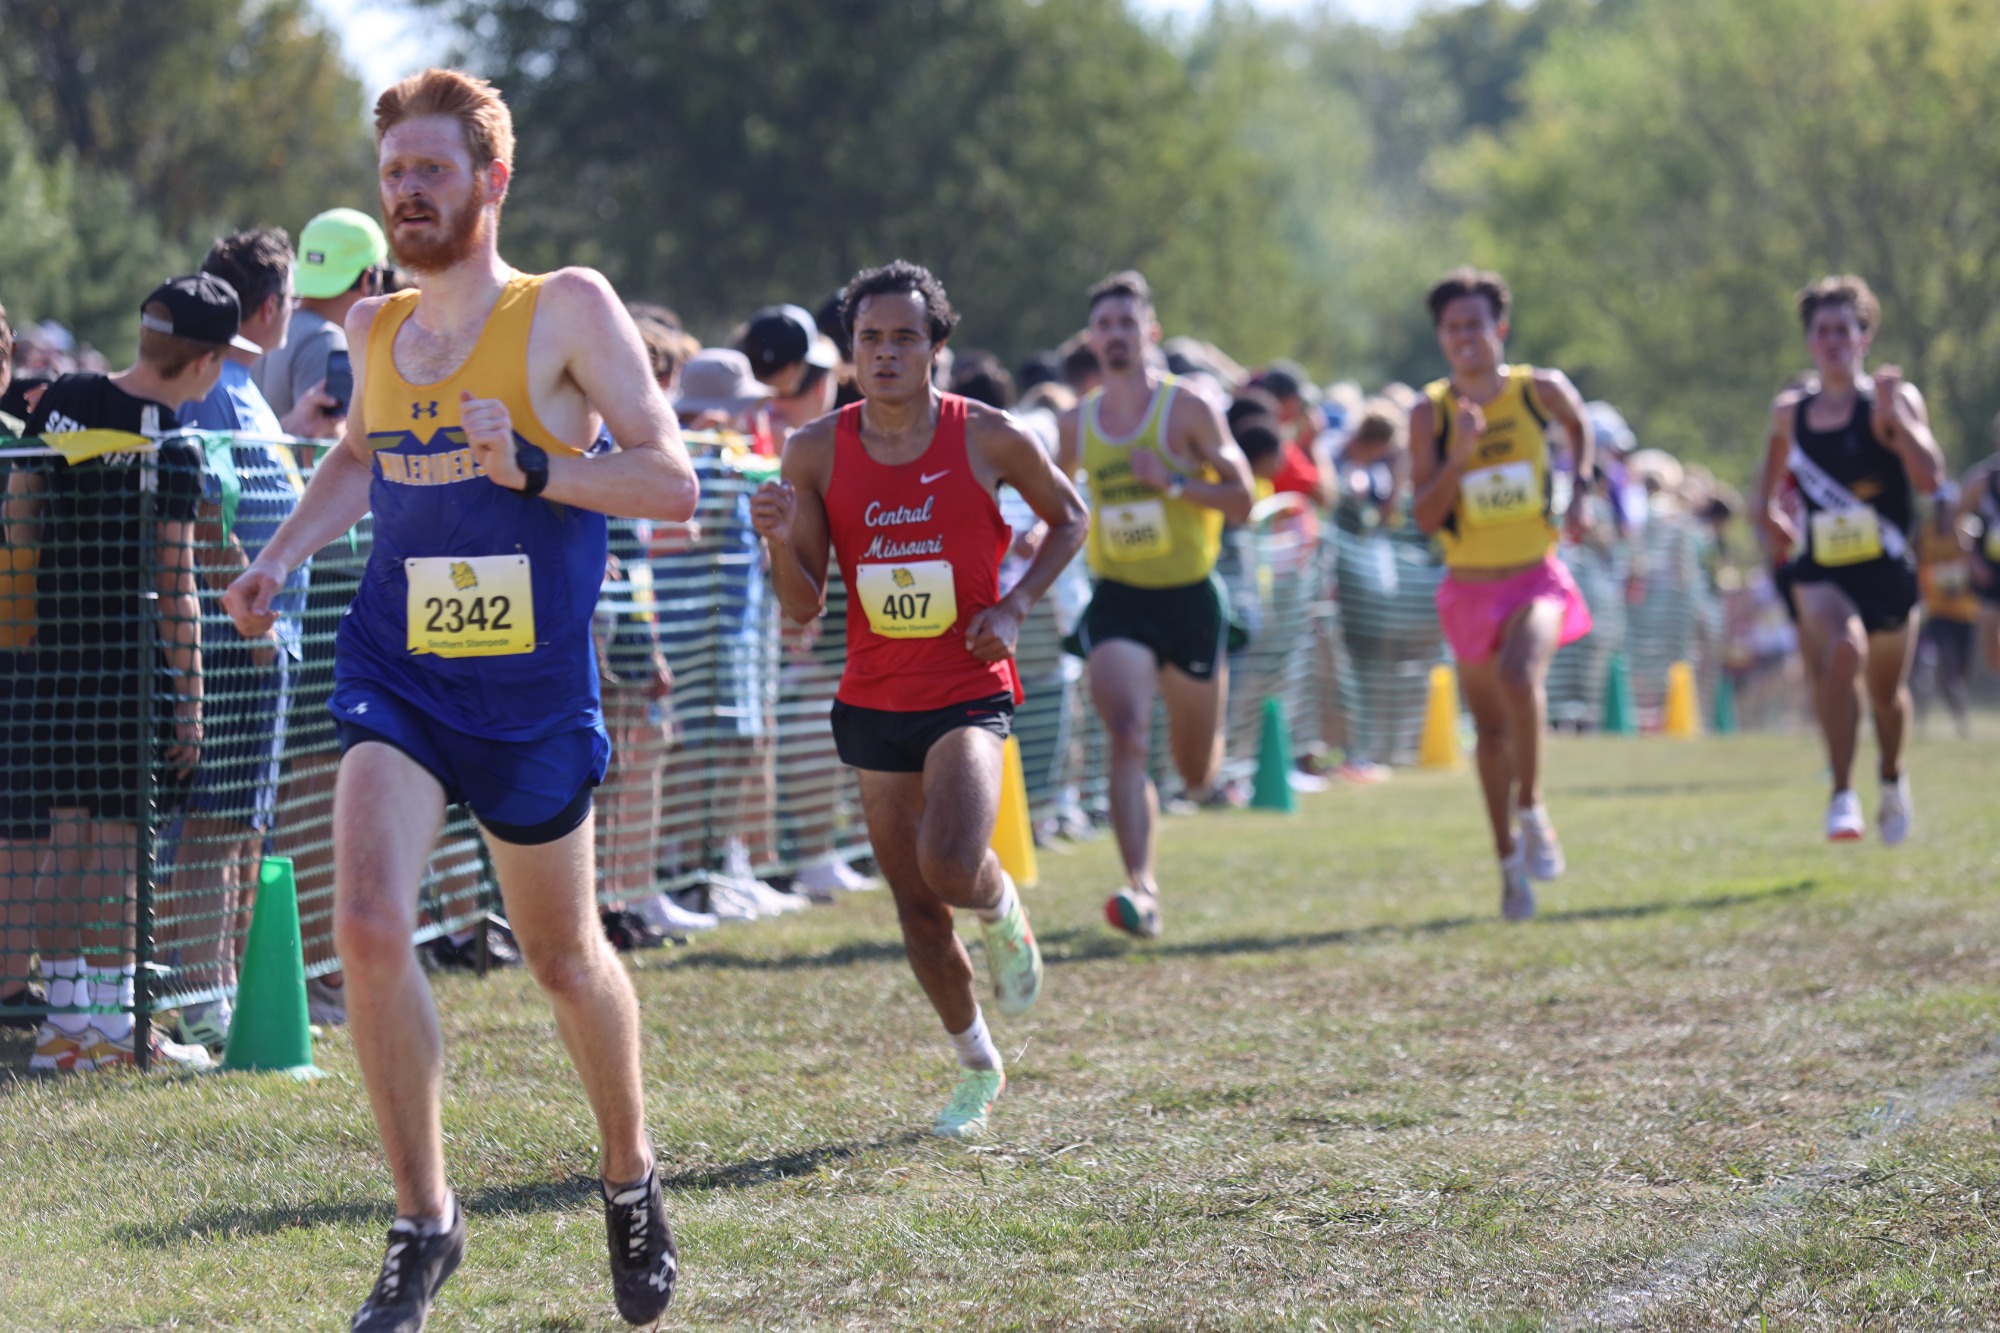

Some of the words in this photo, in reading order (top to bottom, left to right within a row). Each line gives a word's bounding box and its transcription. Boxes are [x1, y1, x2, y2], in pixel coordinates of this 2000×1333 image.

[864, 495, 935, 528] Central
[864, 533, 944, 559] Missouri
[425, 595, 512, 633] 2342
[882, 593, 931, 620] 407
[428, 639, 463, 648] Southern
[465, 638, 509, 648] Stampede
